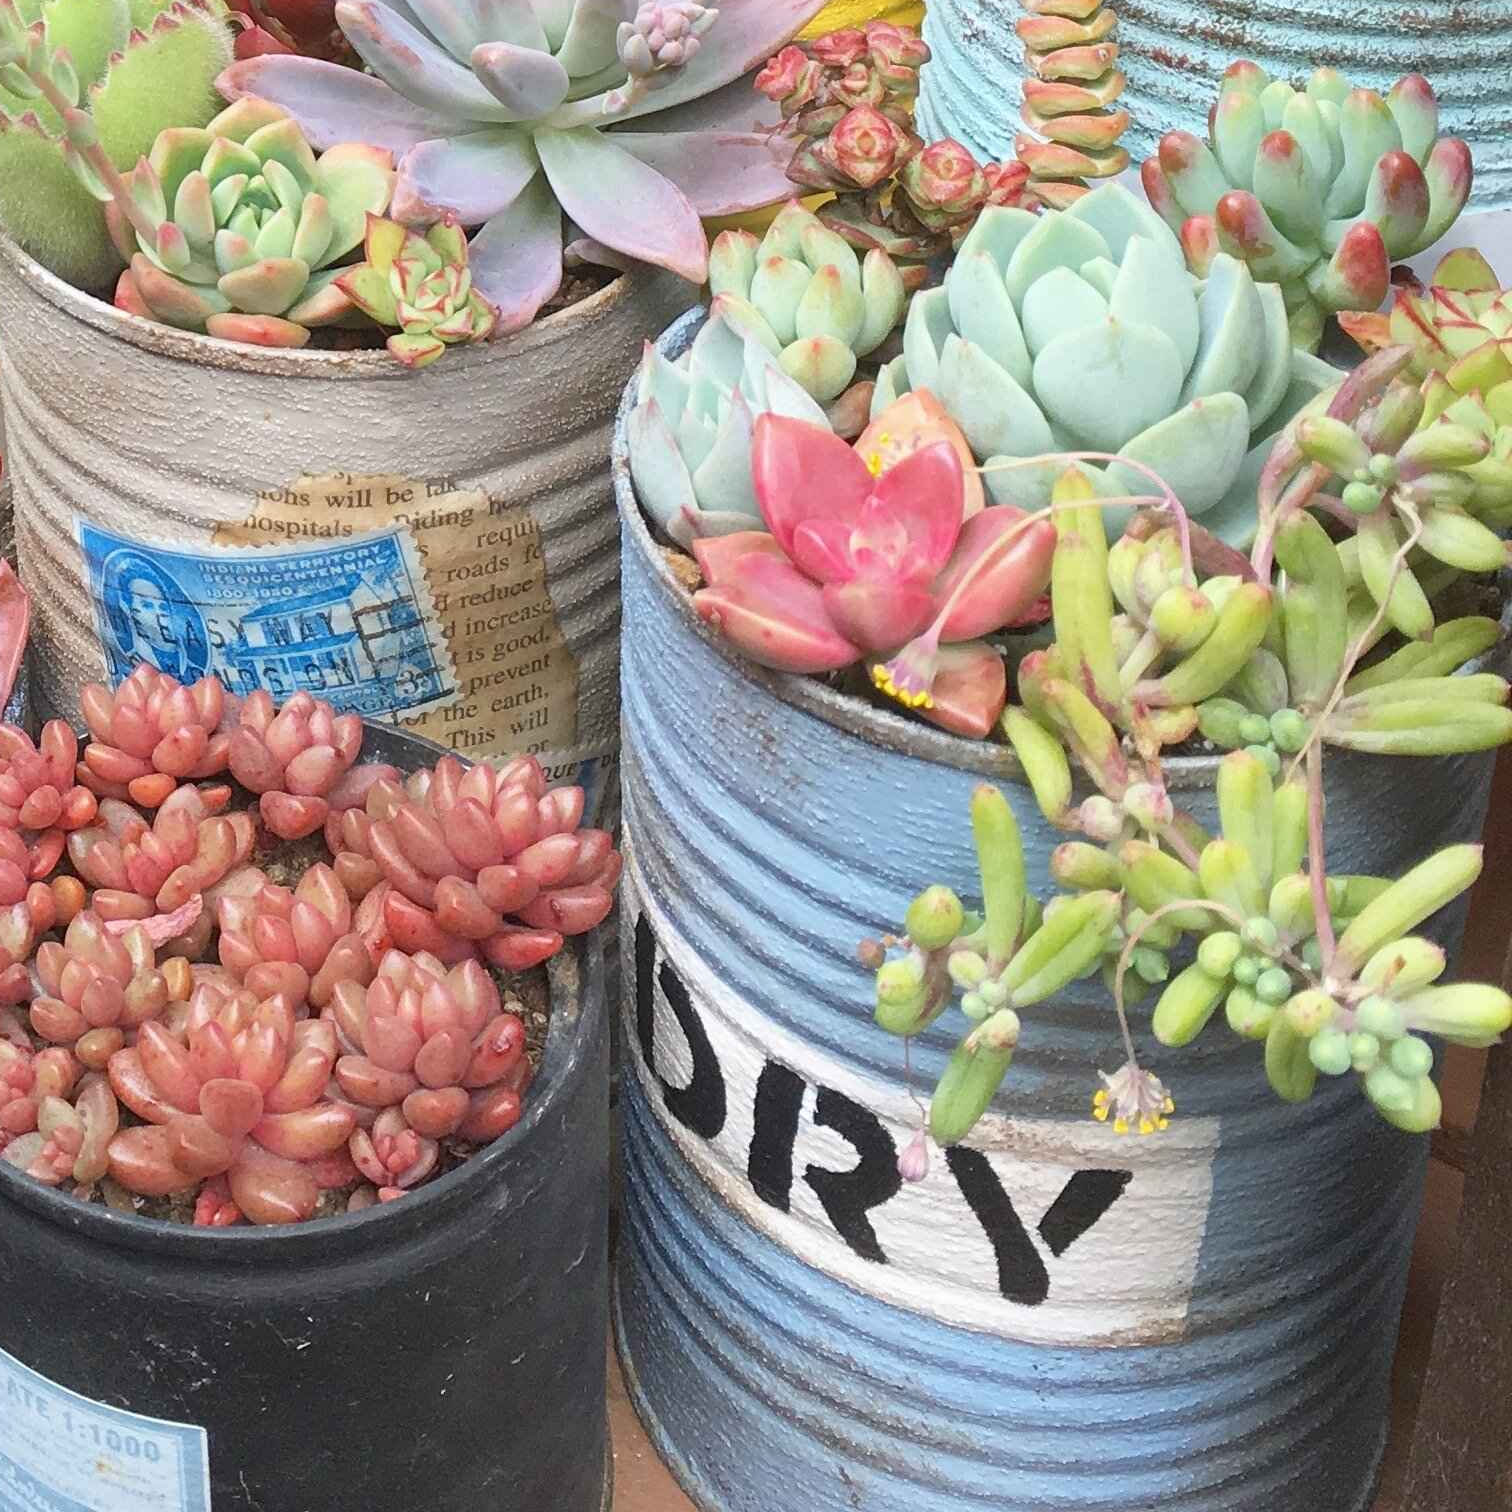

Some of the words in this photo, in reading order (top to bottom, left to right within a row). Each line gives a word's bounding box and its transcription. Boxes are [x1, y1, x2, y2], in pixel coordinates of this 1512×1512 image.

[324, 487, 372, 510] will
[386, 485, 414, 506] be
[243, 511, 353, 540] hospitals
[198, 561, 270, 575] INDIANA
[274, 543, 381, 571] TERRITORY
[202, 555, 388, 586] SESQUICENTENNIAL
[445, 554, 511, 583] roads
[458, 578, 534, 609] reduce
[464, 598, 552, 637] increase
[467, 646, 486, 664] is
[467, 652, 551, 696] prevent
[443, 702, 479, 723] the
[445, 729, 496, 750] This
[510, 706, 550, 735] will
[62, 1410, 163, 1463] 1:1000
